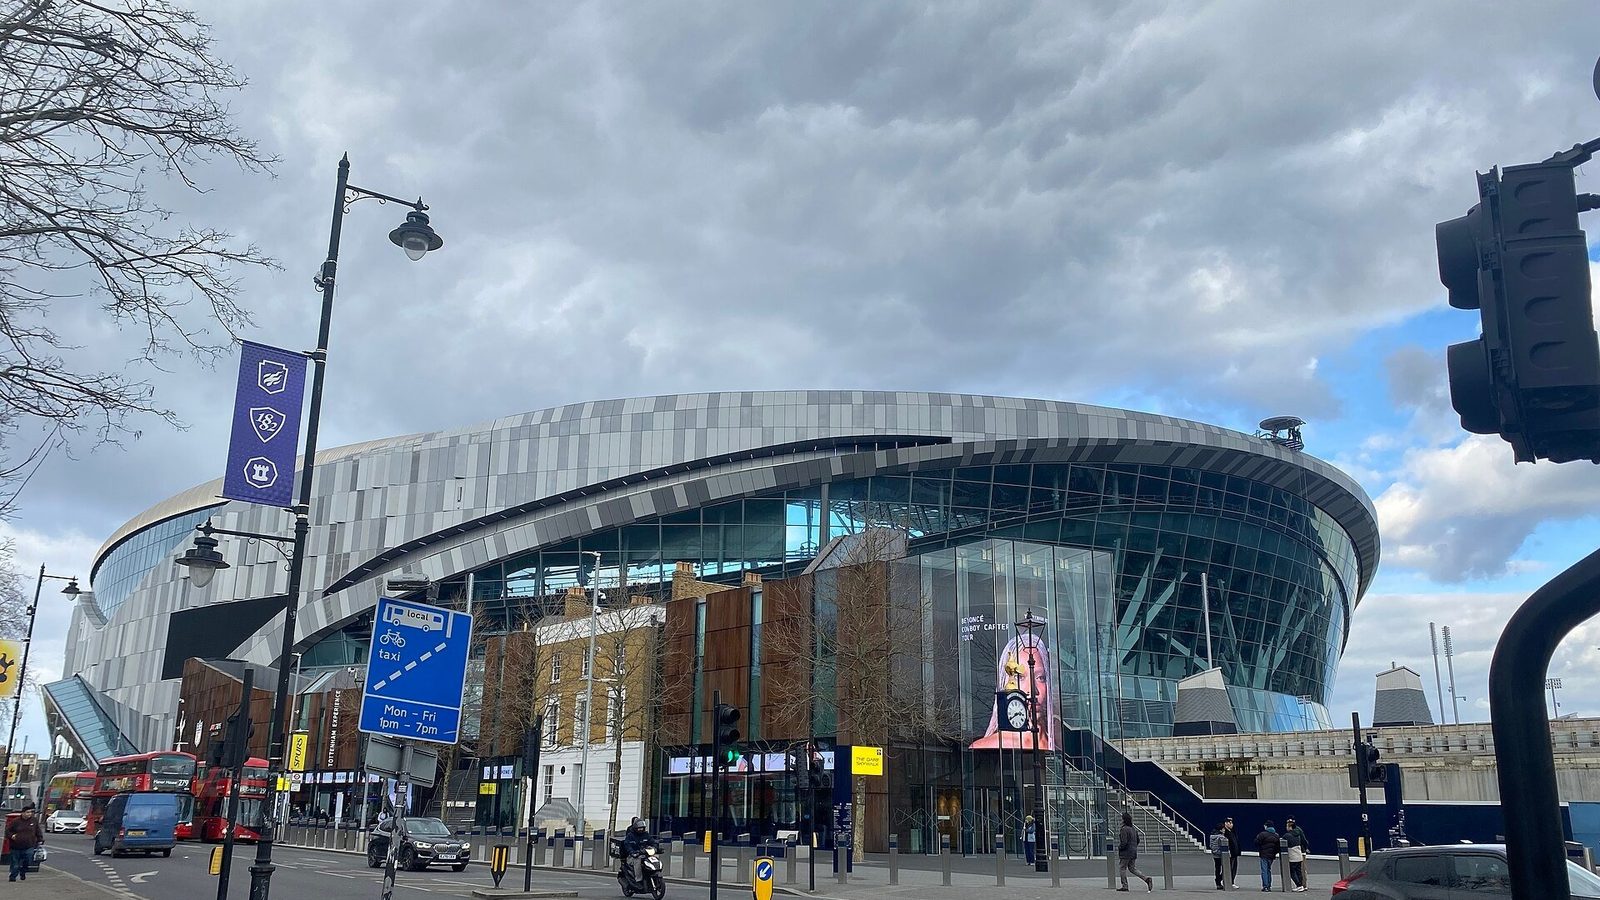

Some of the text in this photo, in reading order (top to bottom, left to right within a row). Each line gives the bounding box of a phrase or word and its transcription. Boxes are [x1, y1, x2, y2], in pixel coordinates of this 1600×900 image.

[407, 610, 429, 621] local
[379, 649, 401, 662] taxi
[384, 704, 407, 718] Mon
[423, 710, 437, 722] Fri
[328, 690, 341, 767] TOTTENHAM EXPERIENCE
[380, 717, 399, 730] 1pm
[416, 722, 438, 735] 7pm
[294, 737, 303, 768] SPURS
